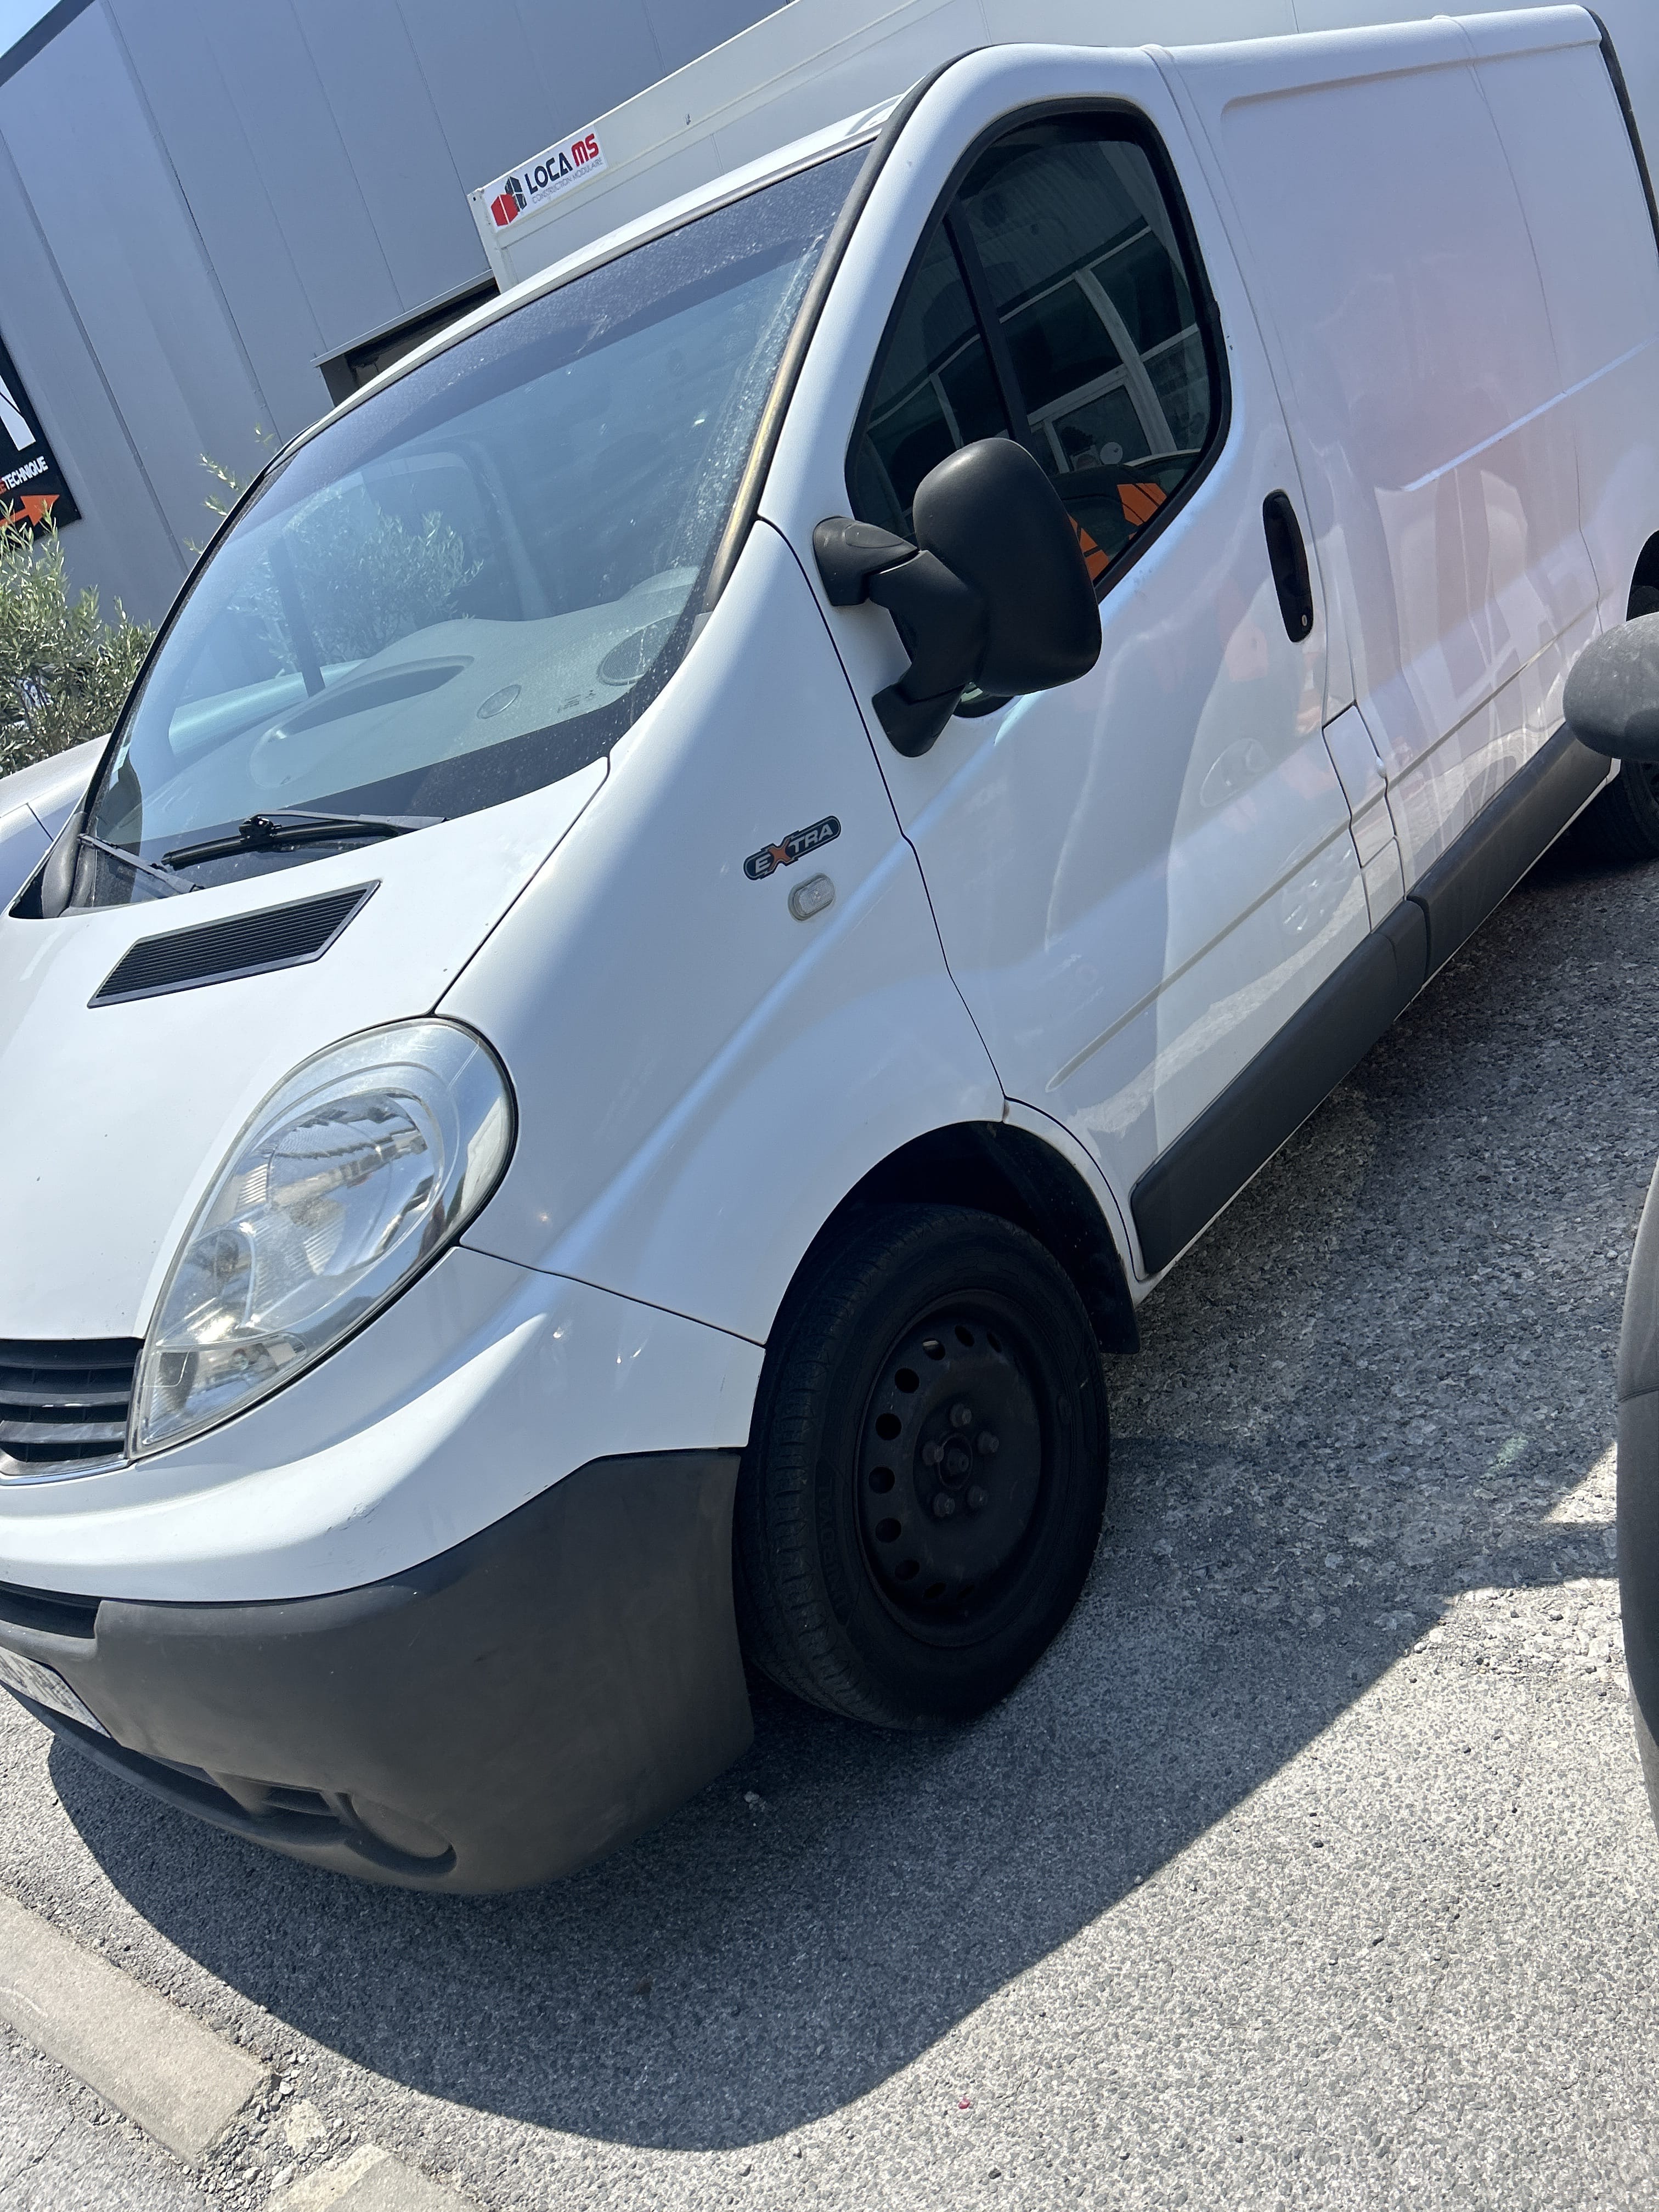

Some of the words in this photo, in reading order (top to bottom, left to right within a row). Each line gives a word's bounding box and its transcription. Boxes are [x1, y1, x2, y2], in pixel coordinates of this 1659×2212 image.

[524, 152, 573, 195] LOCA
[571, 133, 599, 167] MS
[755, 824, 833, 874] EXTRA
